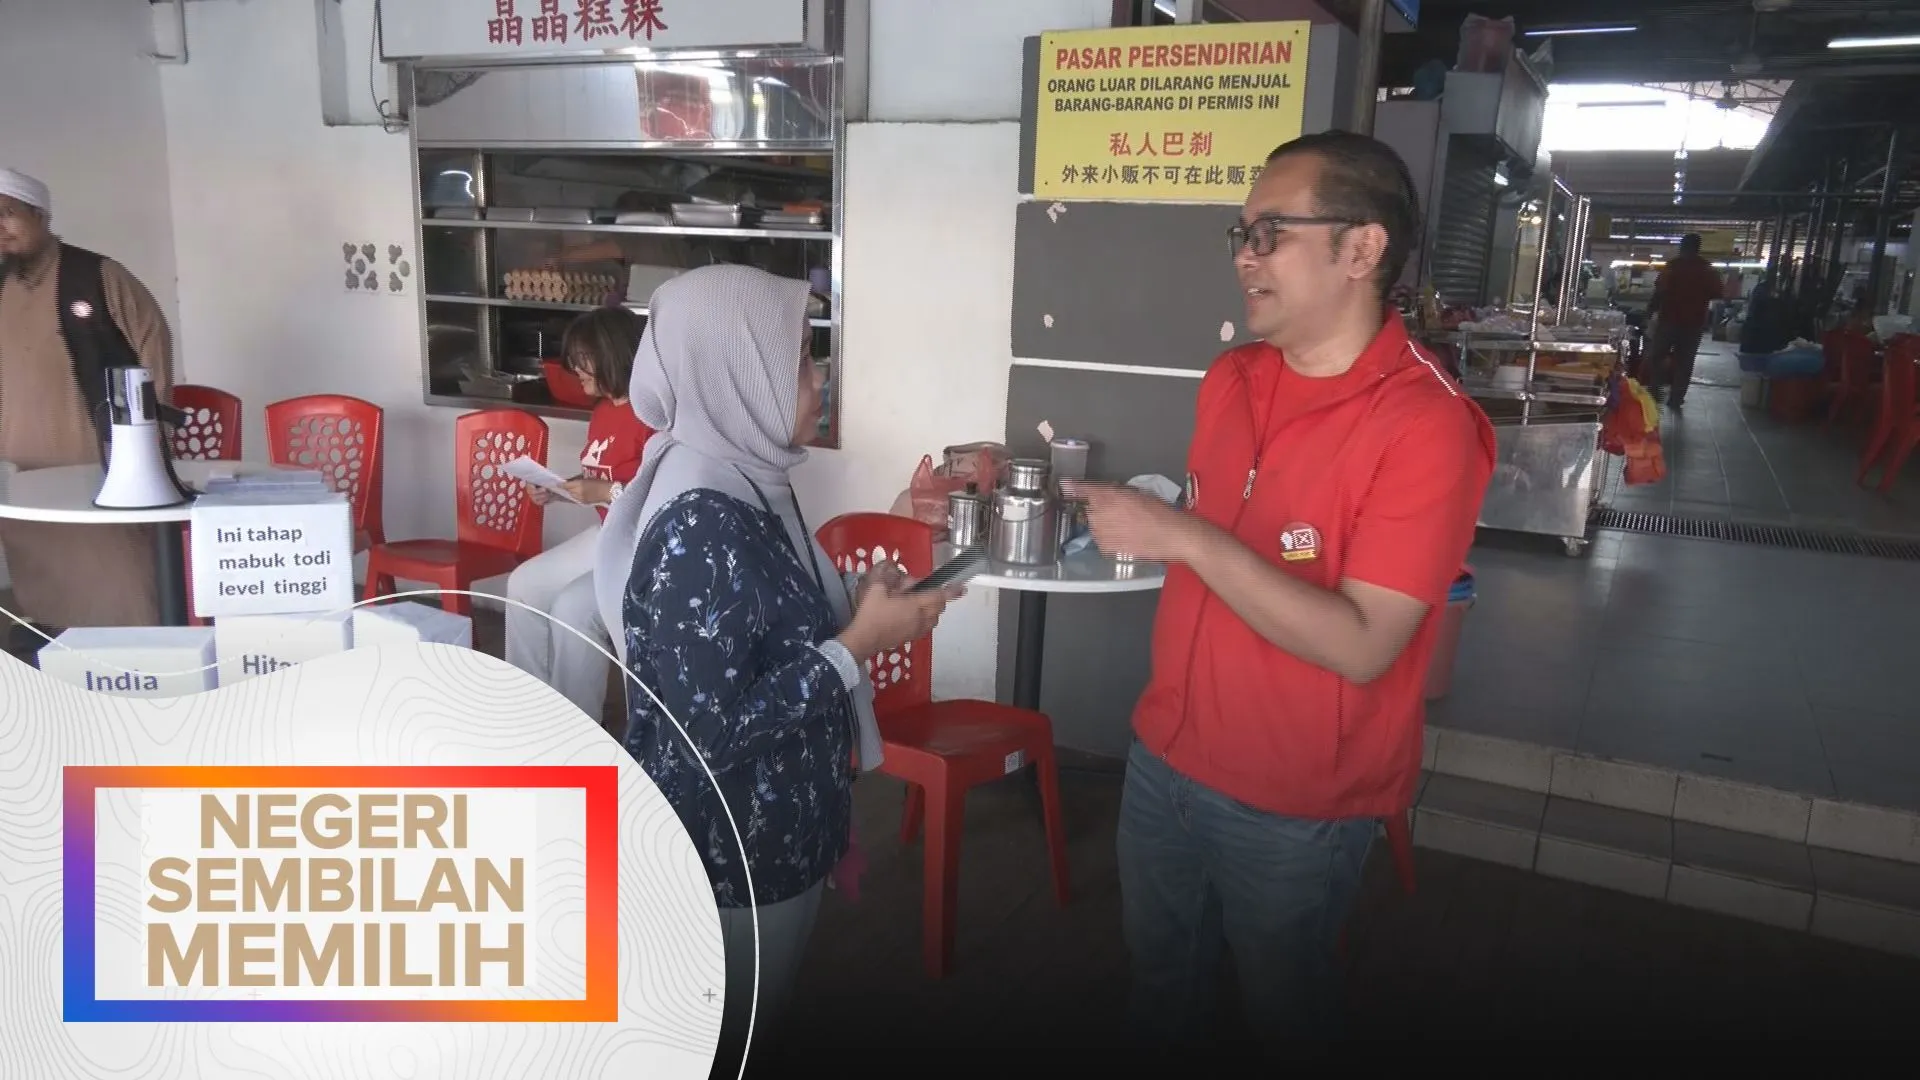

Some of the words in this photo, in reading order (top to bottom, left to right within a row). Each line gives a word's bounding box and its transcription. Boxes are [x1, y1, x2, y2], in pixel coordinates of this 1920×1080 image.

[1055, 47, 1122, 70] PASAR
[1128, 40, 1293, 68] PERSENDIRIAN
[1047, 78, 1096, 94] ORANG
[1099, 77, 1136, 92] LUAR
[1140, 75, 1214, 91] DILARANG
[1218, 73, 1291, 89] MENJUAL
[1054, 96, 1175, 112] BARANG-BARANG
[1178, 95, 1193, 111] DI
[1198, 94, 1253, 110] PERMIS
[1258, 94, 1280, 109] INI
[1109, 131, 1213, 157] 私人巴刹
[217, 527, 242, 544] Ini
[248, 526, 303, 544] tahap
[218, 553, 285, 569] mabuk
[293, 550, 331, 567] todi
[218, 580, 265, 596] level
[274, 577, 327, 597] tinggi
[85, 669, 159, 692] India
